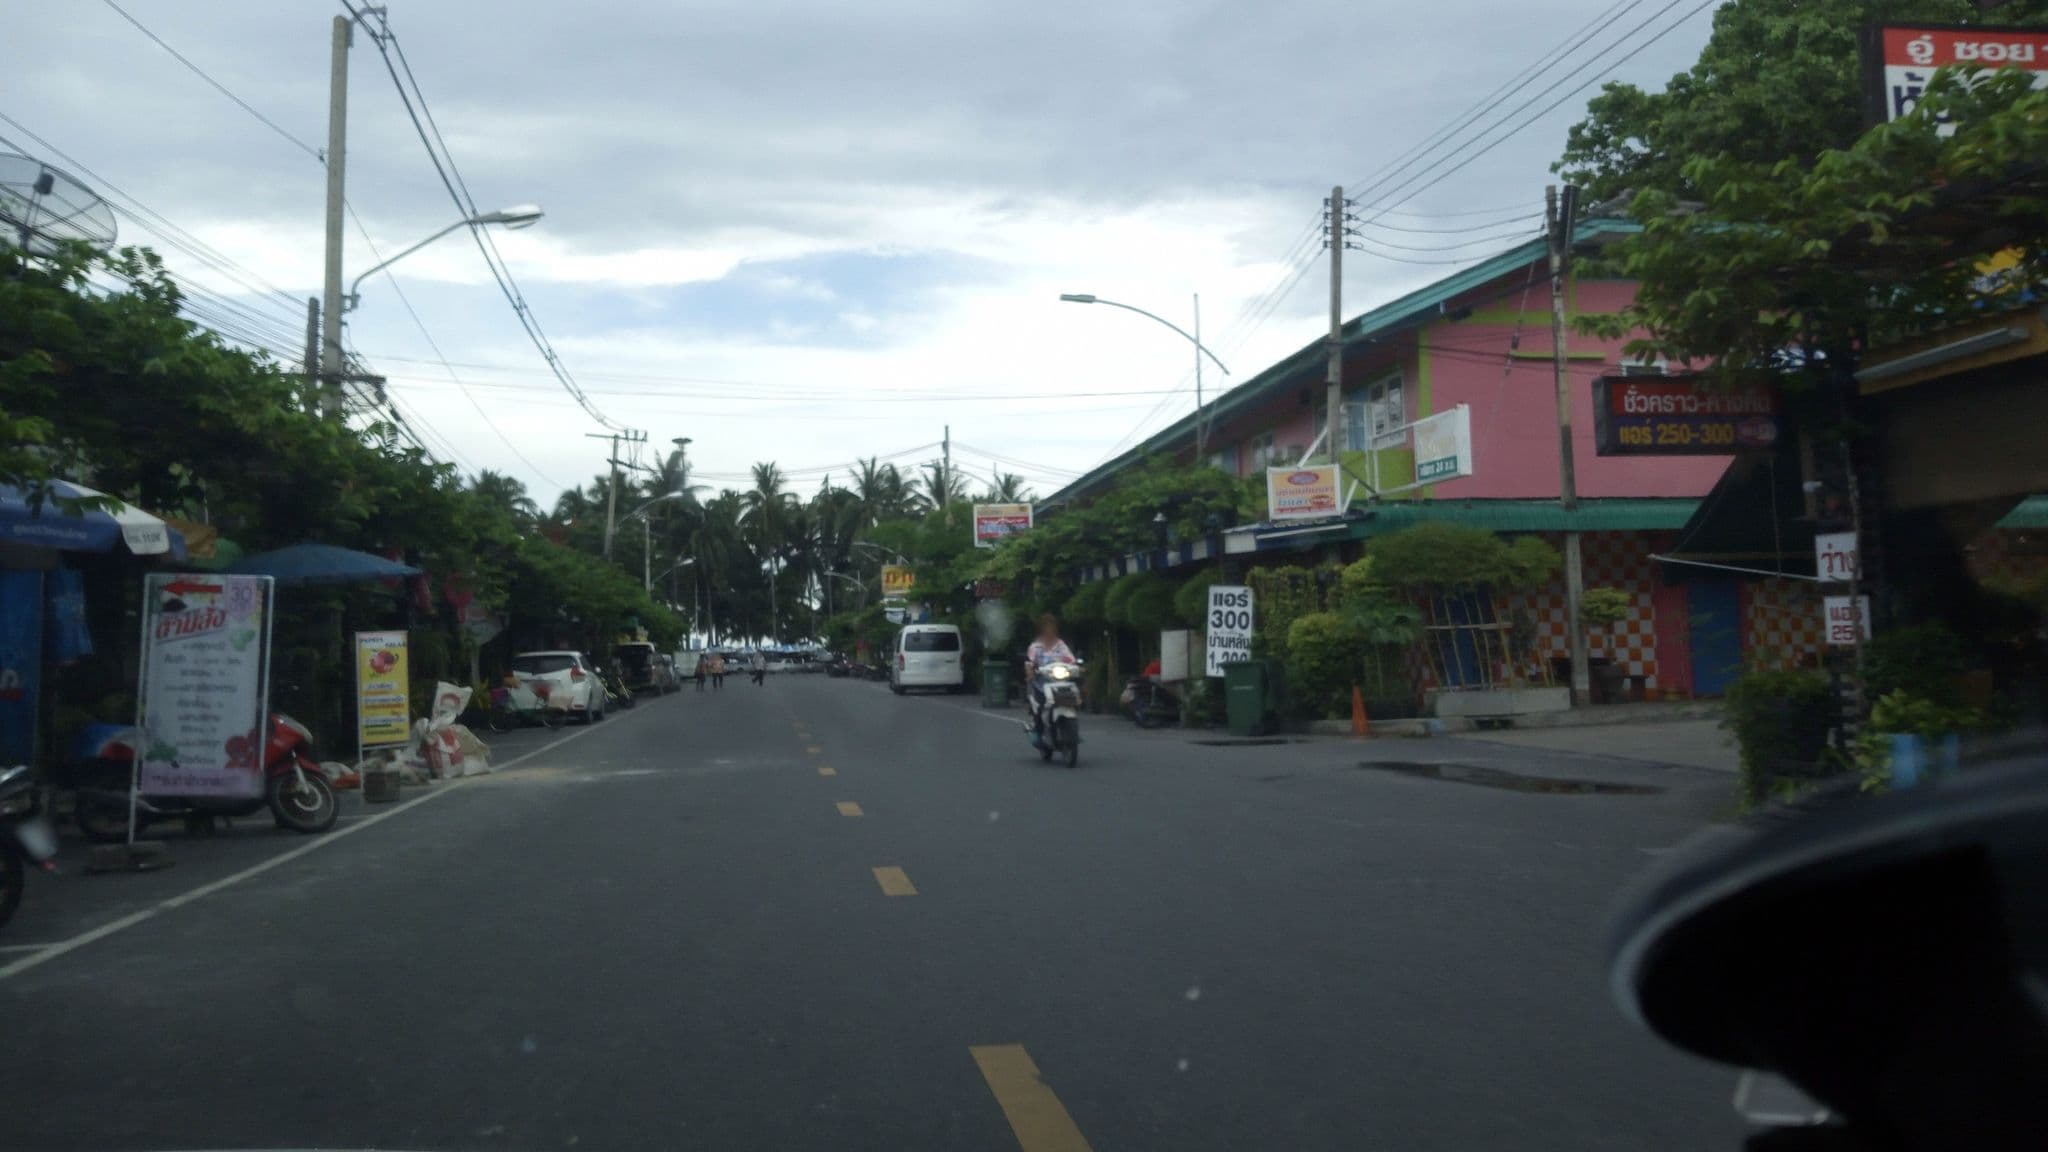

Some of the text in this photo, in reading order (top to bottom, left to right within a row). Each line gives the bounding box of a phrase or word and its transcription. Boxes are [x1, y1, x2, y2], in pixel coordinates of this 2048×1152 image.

[1620, 419, 1652, 445] แอร์
[1657, 423, 1734, 444] 250-300
[1213, 589, 1248, 607] แอร์
[156, 600, 227, 640] ตามสั่ง
[1211, 610, 1250, 629] 300
